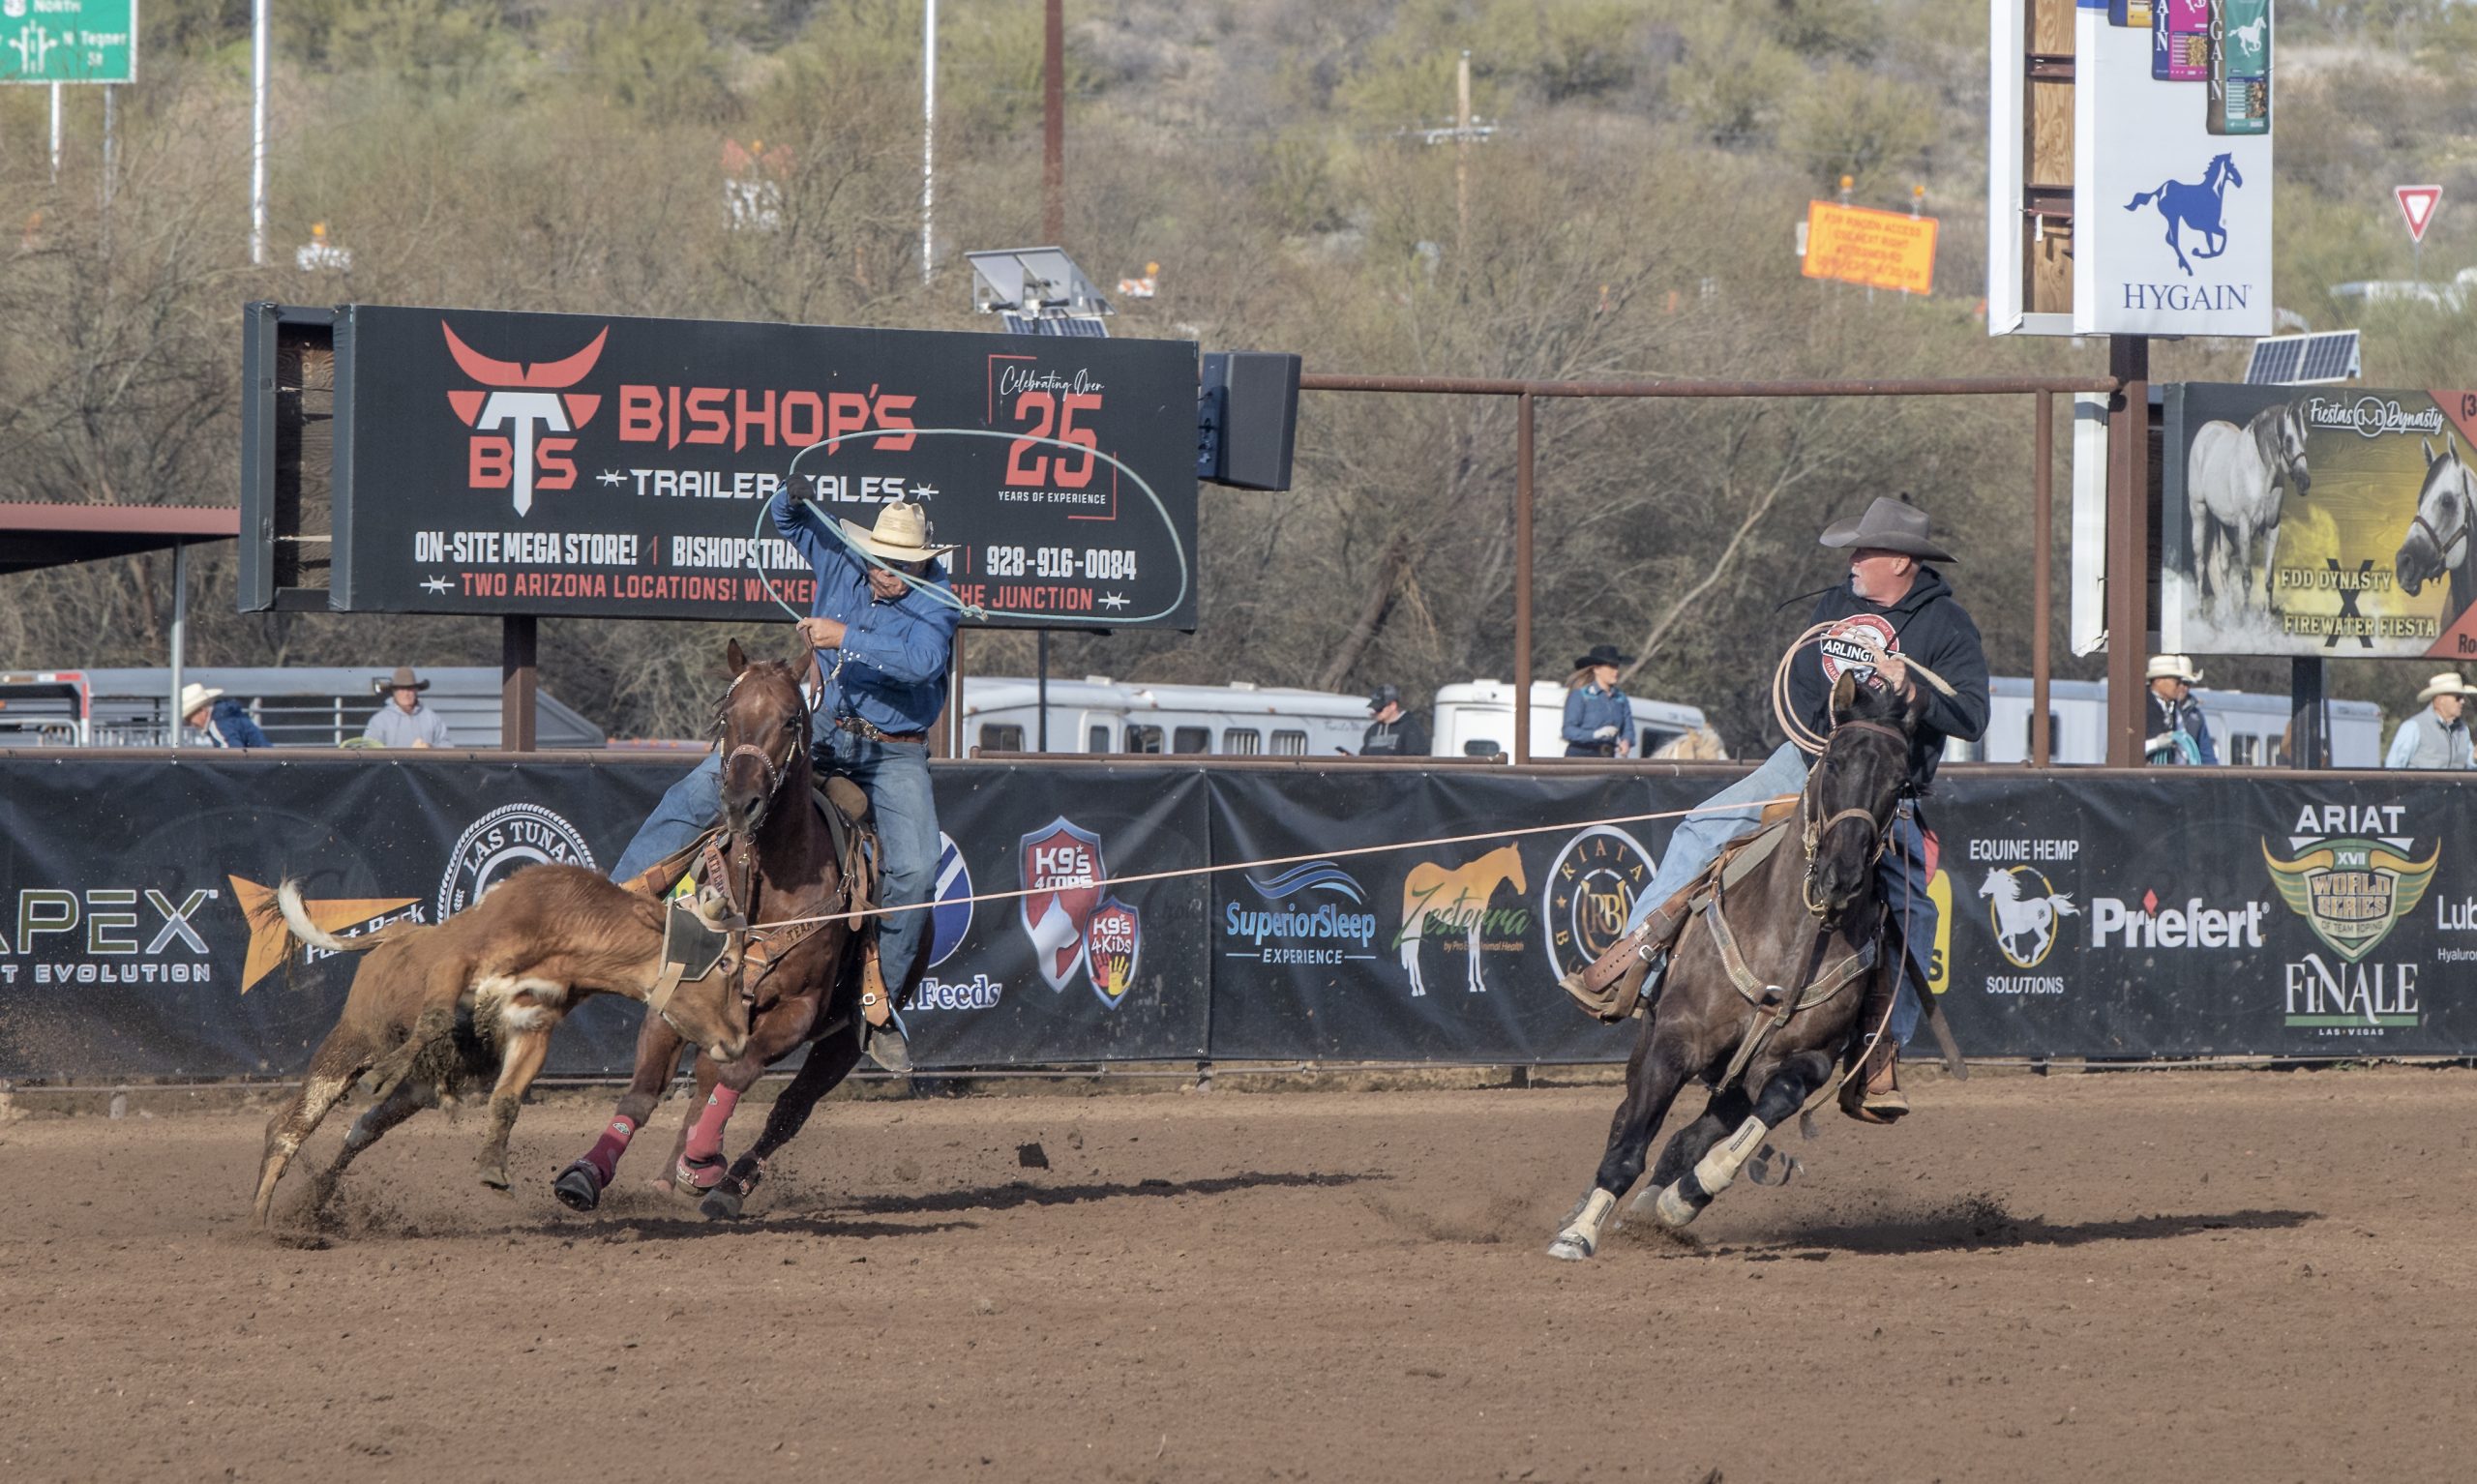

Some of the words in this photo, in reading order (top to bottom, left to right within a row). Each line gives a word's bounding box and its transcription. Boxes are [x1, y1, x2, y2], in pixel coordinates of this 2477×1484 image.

[63, 31, 74, 45] N
[81, 31, 126, 48] Tegner
[2123, 283, 2247, 311] HYGAIN
[1000, 366, 1071, 401] Celebrating
[1075, 369, 1105, 397] Over
[619, 384, 917, 457] BISHOP'S
[2311, 398, 2354, 424] Fiestas
[2386, 401, 2444, 435] Dynasty
[1005, 392, 1102, 488] 25
[805, 475, 906, 503] ALES
[999, 491, 1029, 501] YEARS
[1032, 492, 1044, 501] OF
[1048, 492, 1106, 504] EXPERIENCE
[415, 532, 499, 563] ON-SITE
[503, 533, 561, 564] MEGA
[565, 535, 638, 565] STORE!
[987, 546, 1137, 580] 928-916-0084
[462, 573, 507, 597] TWO
[514, 574, 607, 598] ARIZONA
[613, 576, 737, 601] LOCATIONS!
[2319, 571, 2391, 589] DYNASTY
[993, 585, 1092, 610] JUNCTION
[2283, 615, 2374, 636] FIREWATER
[2379, 618, 2435, 637] FIESTA
[2295, 805, 2406, 834] ARIAT
[463, 827, 505, 876] LAS
[1561, 838, 1643, 883] RIATA
[1970, 839, 2030, 861] EQUINE
[2034, 840, 2079, 861] HEMP
[2338, 852, 2366, 865] XVII
[2311, 873, 2390, 896] WORLD
[1391, 881, 1531, 952] Zesterra
[2317, 896, 2386, 919] SERIES
[787, 923, 814, 941] TEAM
[1226, 902, 1376, 948] SuperiorSleep
[2334, 922, 2353, 933] TEAM
[1263, 948, 1343, 965] EXPERIENCE
[1502, 940, 1524, 952] Health
[35, 964, 210, 983] EVOLUTION
[1986, 976, 2065, 994] SOLUTIONS
[916, 973, 1002, 1010] Feeds
